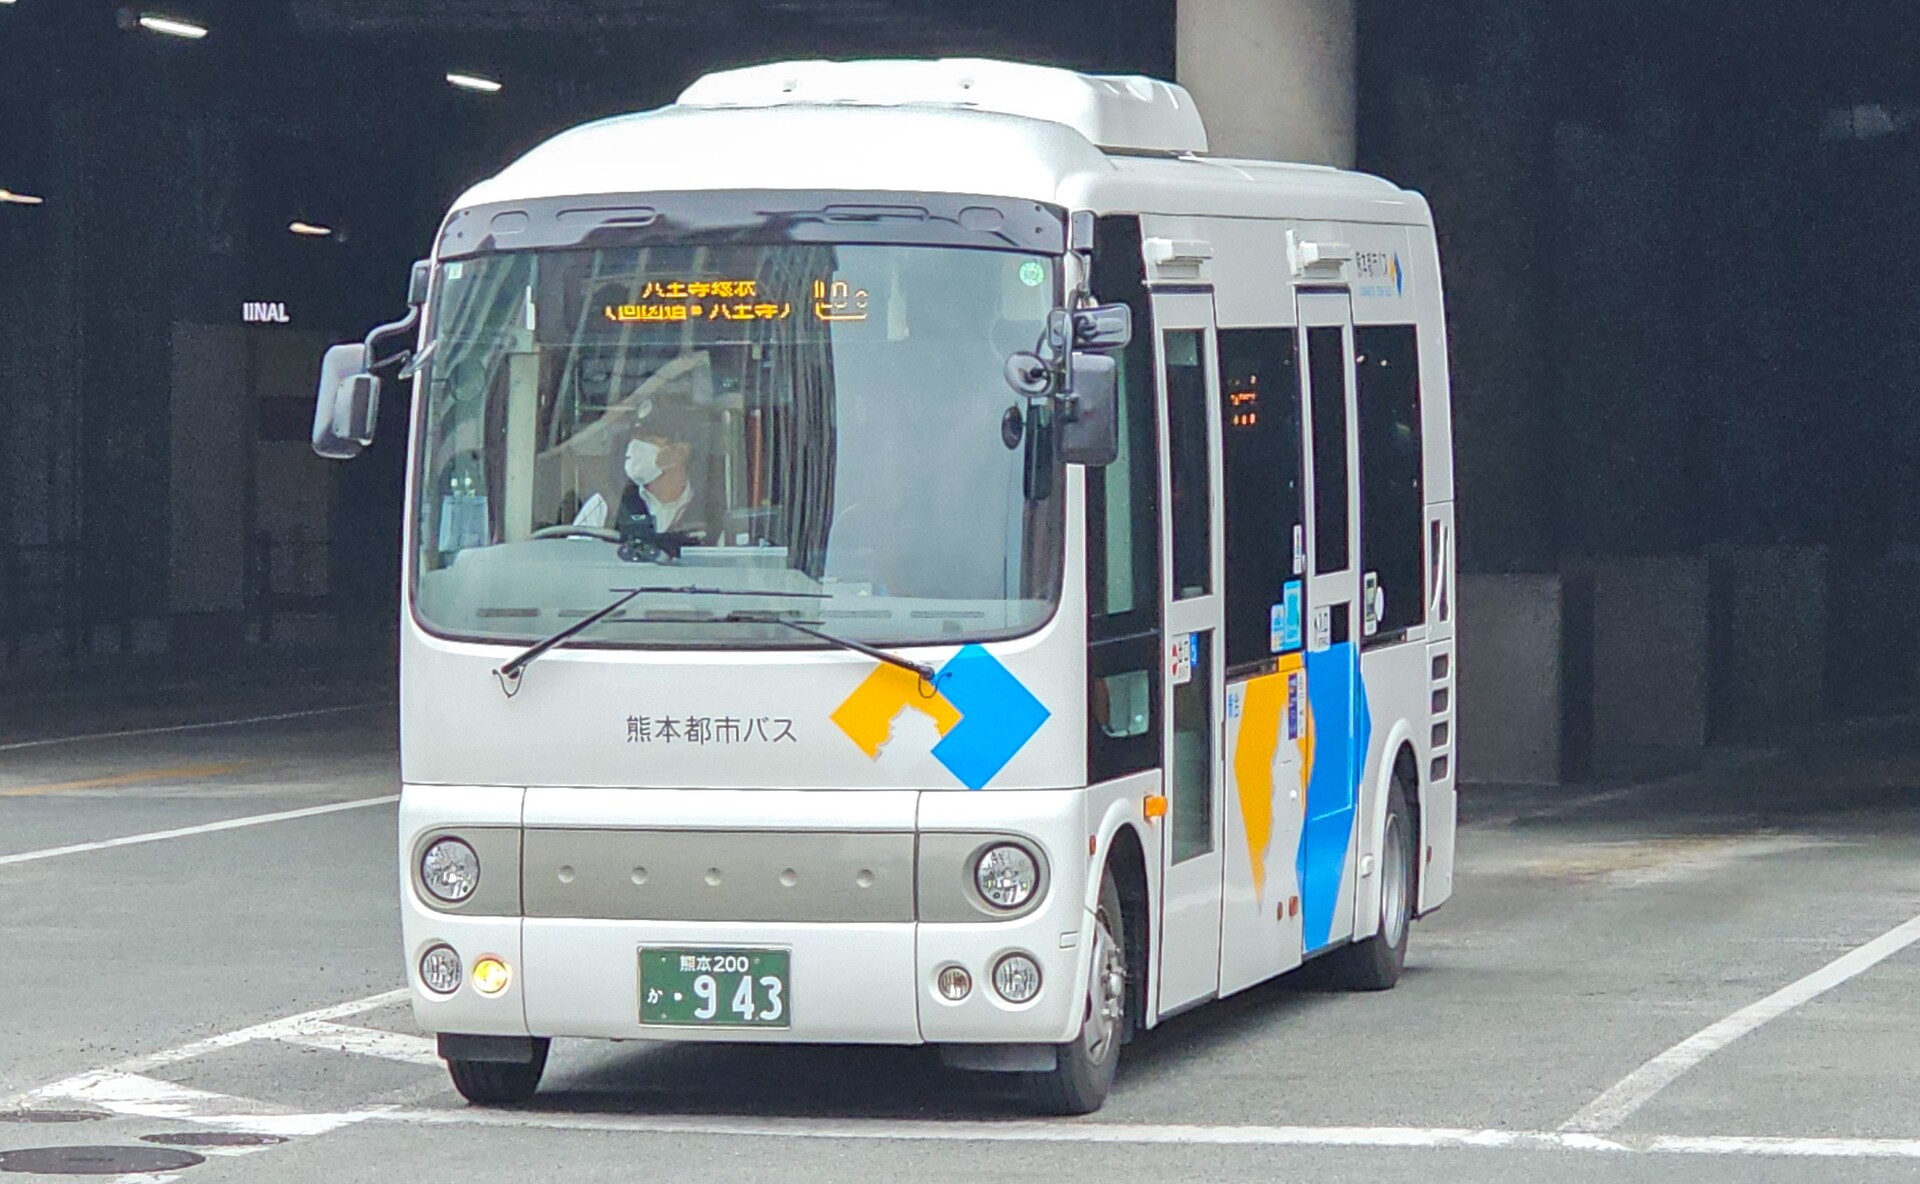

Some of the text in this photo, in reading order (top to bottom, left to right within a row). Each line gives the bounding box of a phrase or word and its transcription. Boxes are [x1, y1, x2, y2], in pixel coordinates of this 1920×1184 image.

[626, 714, 798, 746] 熊本都市バス
